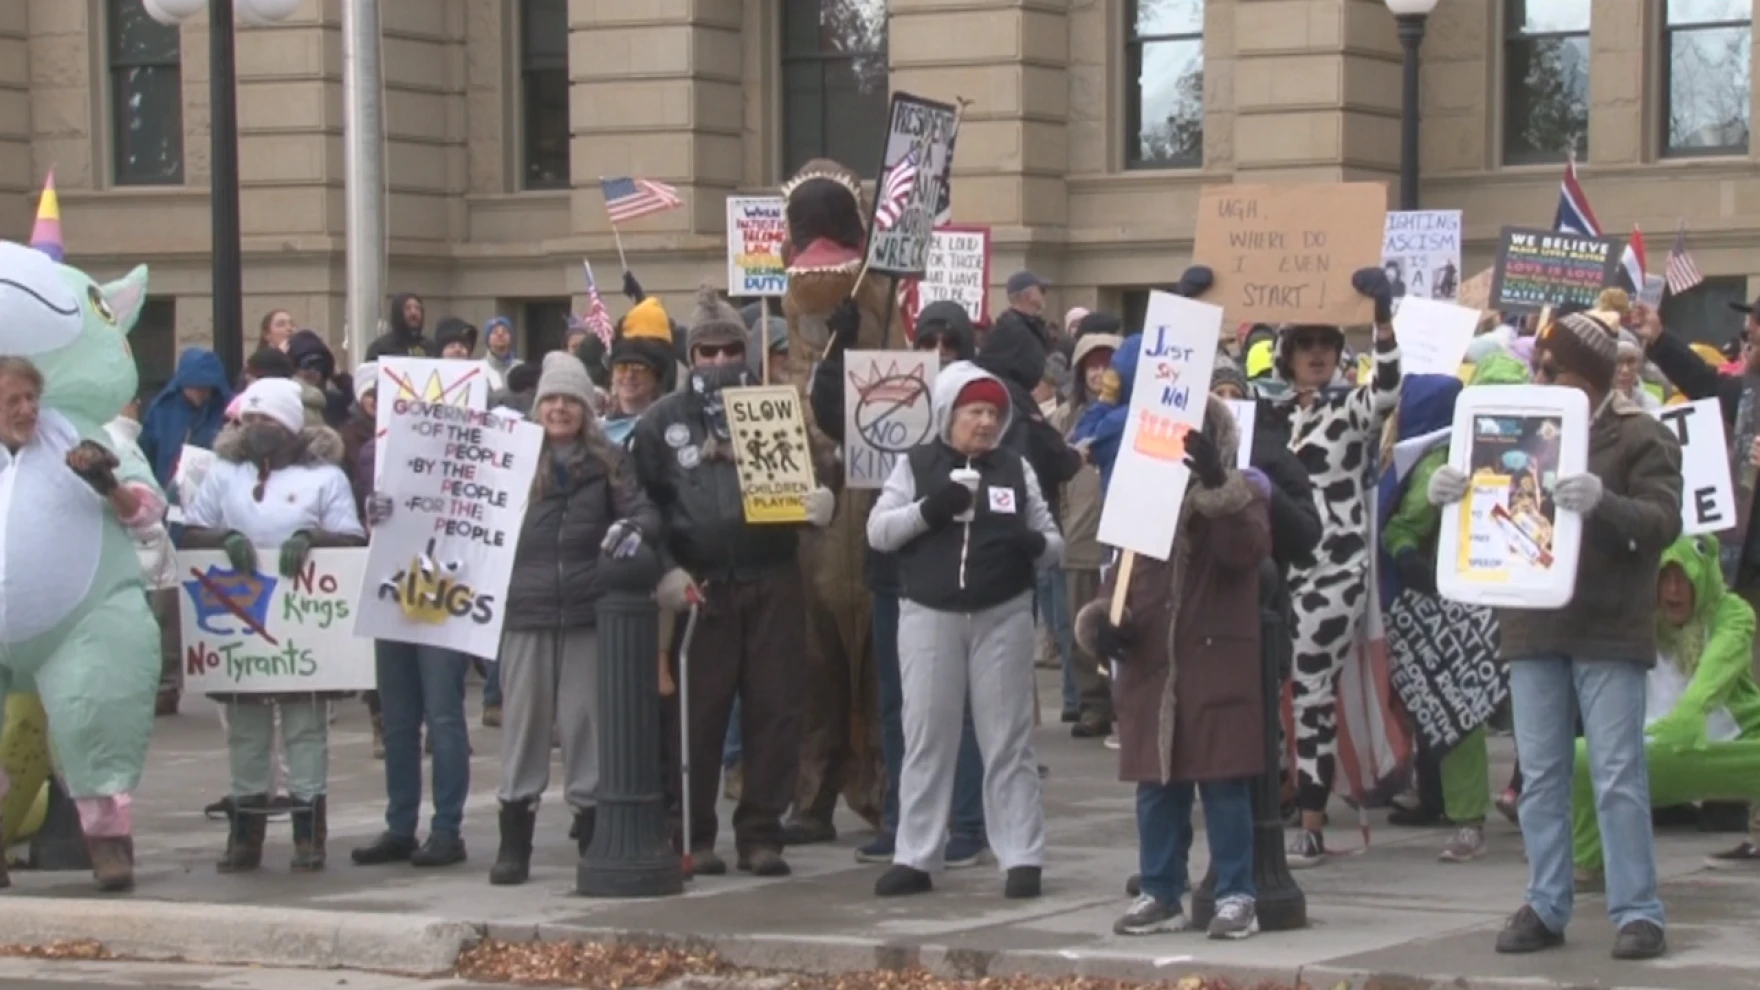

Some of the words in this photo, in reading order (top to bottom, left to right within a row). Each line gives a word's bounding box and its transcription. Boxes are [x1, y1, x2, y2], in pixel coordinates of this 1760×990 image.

[1389, 213, 1458, 231] IGHTING
[947, 236, 978, 251] LOUD
[1229, 230, 1286, 250] WHERE
[1302, 230, 1327, 249] DO
[1385, 233, 1457, 252] ASCISM
[1511, 233, 1536, 247] WE
[1542, 236, 1610, 255] BELIEVE
[1231, 254, 1246, 273] I
[1278, 254, 1330, 273] EVEN
[1506, 261, 1542, 275] LOVE
[1567, 267, 1604, 281] LOVE
[744, 277, 785, 290] DUTY
[1411, 270, 1424, 287] A
[1502, 288, 1545, 300] WATER
[392, 399, 519, 434] GOVERNMENT
[732, 400, 793, 422] SLOW
[447, 425, 482, 445] THE
[869, 420, 908, 446] NO
[444, 443, 515, 470] PEOPLE
[849, 445, 897, 480] KIN
[441, 460, 477, 480] THE
[440, 479, 509, 508] PEOPLE
[746, 483, 809, 495] CHILDREN
[450, 500, 484, 521] THE
[433, 518, 506, 547] PEOPLE
[294, 560, 338, 595] No
[283, 591, 350, 629] Kings
[1390, 597, 1441, 672] VOTING
[187, 640, 220, 676] No
[219, 638, 318, 684] Tyrants
